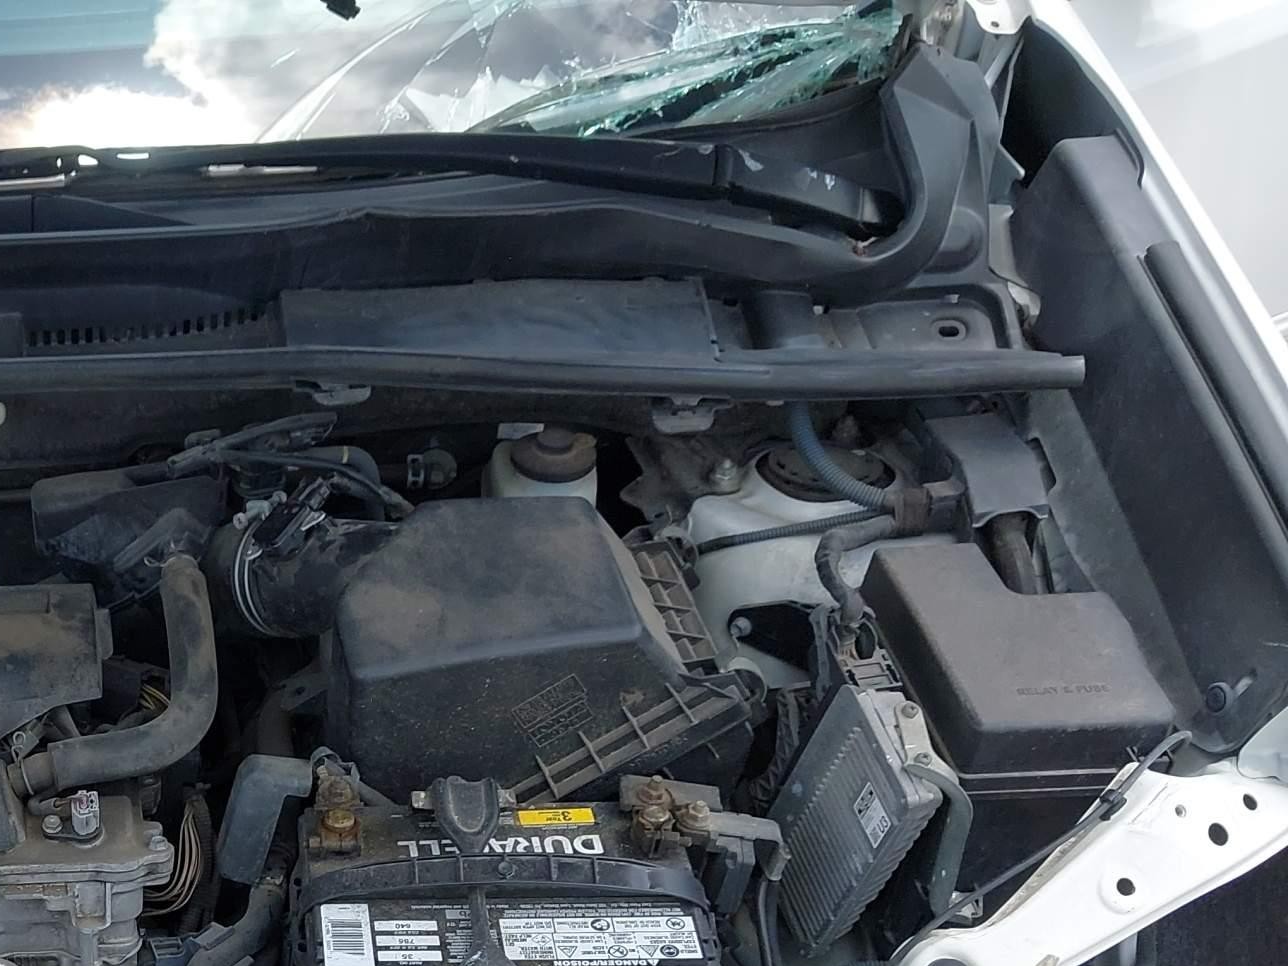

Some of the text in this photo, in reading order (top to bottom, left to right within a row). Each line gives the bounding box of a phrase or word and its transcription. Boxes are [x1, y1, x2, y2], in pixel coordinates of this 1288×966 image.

[1016, 687, 1058, 696] RELAY
[1075, 683, 1111, 694] FUSE
[561, 810, 573, 822] 3
[397, 835, 605, 857] DURAELL
[553, 959, 648, 966] DANGER/POISON
